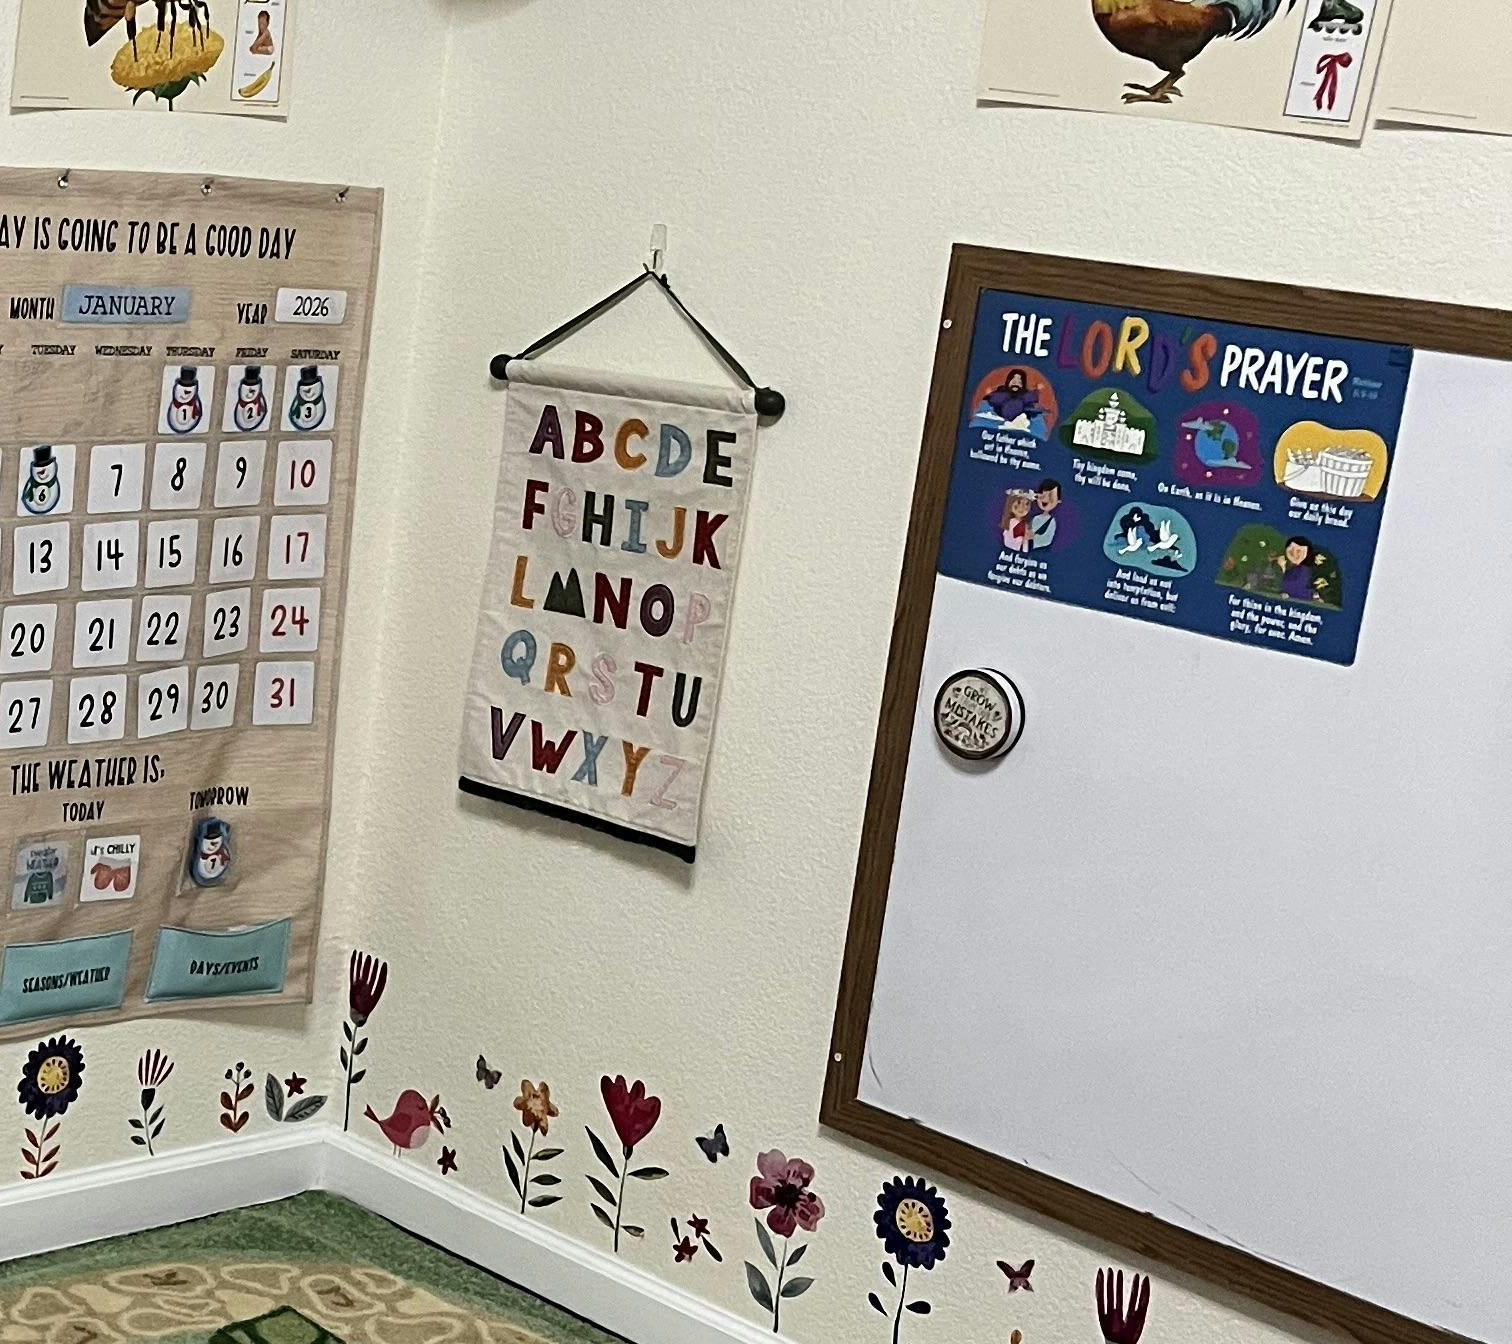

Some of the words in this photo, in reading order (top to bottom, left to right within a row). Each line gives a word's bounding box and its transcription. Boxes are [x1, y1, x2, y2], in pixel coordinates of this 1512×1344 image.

[34, 217, 51, 249] IS
[58, 218, 118, 252] GOING
[128, 222, 150, 253] TO
[157, 222, 179, 255] BE
[185, 223, 196, 255] A
[206, 225, 251, 257] GOOD
[258, 228, 296, 259] DAY
[10, 297, 55, 320] MONTH
[78, 294, 176, 316] JANUARY
[238, 303, 267, 324] YEAR
[293, 296, 329, 317] 2026
[31, 344, 76, 355] TUESDAY
[95, 346, 152, 356] WEDNESDAY
[166, 346, 215, 357] THURSDAY
[236, 348, 268, 357] FRIDAY
[291, 349, 340, 360] SATURDAY
[1002, 312, 1052, 357] THE
[1055, 315, 1218, 394] LORD'S
[1220, 344, 1348, 403] PRAYER
[181, 406, 188, 421] 1
[247, 406, 255, 420] 2
[303, 406, 312, 420] 3
[38, 489, 46, 503] 6
[111, 464, 123, 497] 7
[171, 457, 187, 491] 8
[235, 457, 247, 489] 9
[290, 459, 315, 489] 10
[29, 539, 53, 574] 13
[96, 538, 124, 572] 14
[159, 534, 181, 568] 15
[223, 534, 243, 566] 16
[284, 531, 309, 564] 17
[10, 622, 45, 657] 20
[89, 619, 115, 651] 21
[146, 612, 180, 646] 22
[213, 606, 241, 641] 23
[270, 604, 309, 636] 24
[8, 698, 41, 733] 27
[79, 691, 117, 727] 28
[148, 684, 180, 721] 29
[201, 680, 229, 713] 30
[270, 678, 295, 708] 31
[11, 762, 40, 795] THE
[48, 758, 137, 790] WEATHER
[63, 801, 104, 822] TODAY
[190, 956, 259, 975] DAYS/EVENTS
[23, 967, 110, 993] SEASONS/WEATHER
